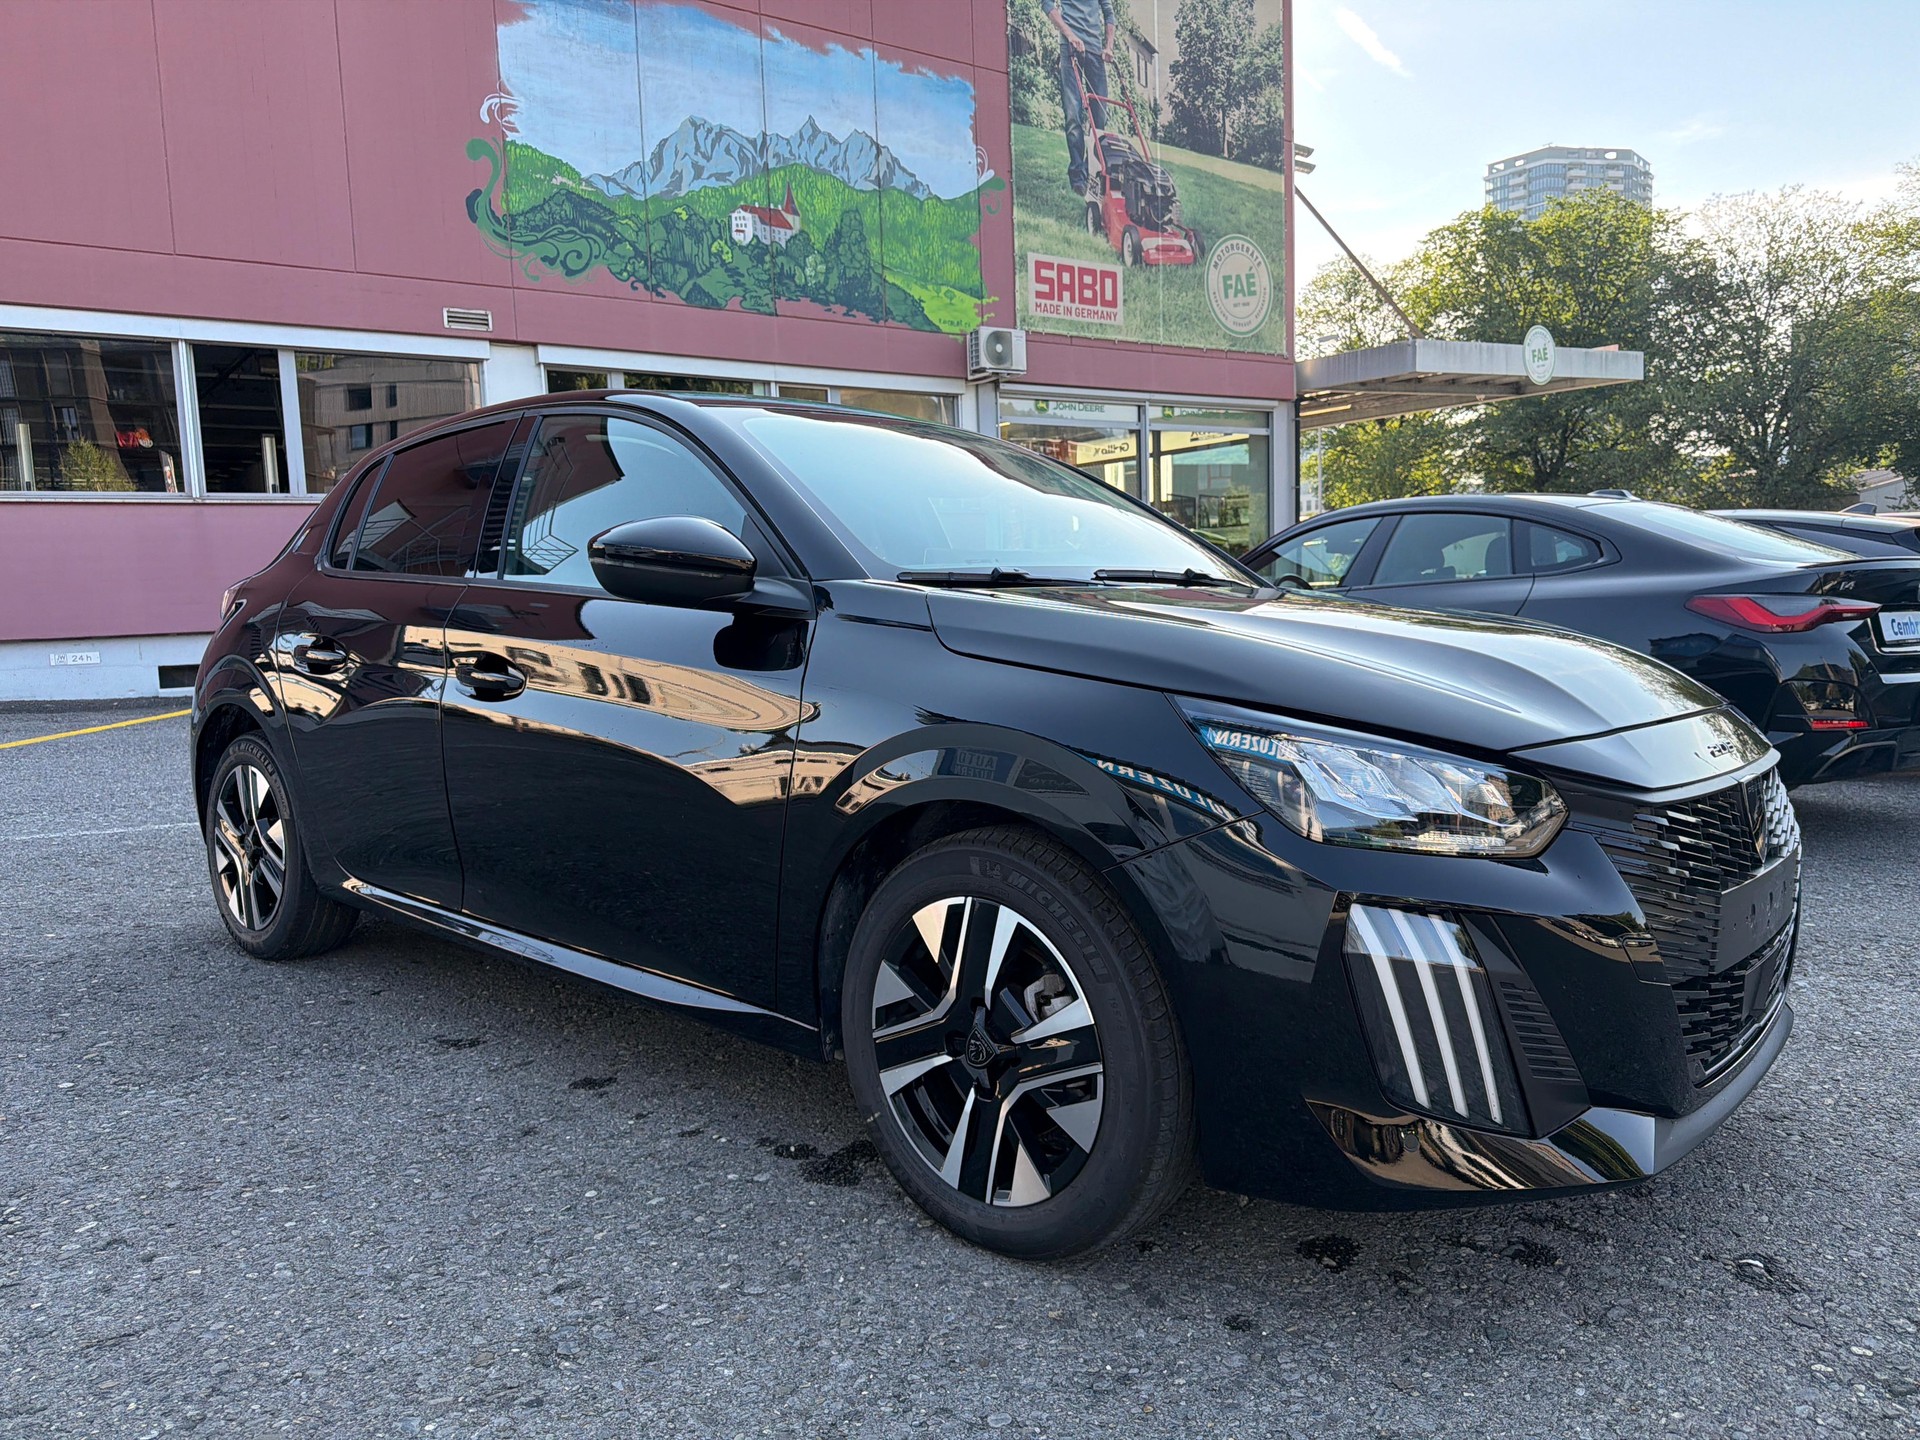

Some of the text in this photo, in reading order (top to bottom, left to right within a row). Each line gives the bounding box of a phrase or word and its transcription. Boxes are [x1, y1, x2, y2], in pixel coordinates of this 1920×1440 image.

[1035, 260, 1118, 309] SABO
[1222, 266, 1257, 299] FAÉ
[1035, 302, 1118, 322] MADE IN GERMANY
[1053, 401, 1105, 413] JOHN DEERE
[1008, 869, 1109, 976] MICHELIN
